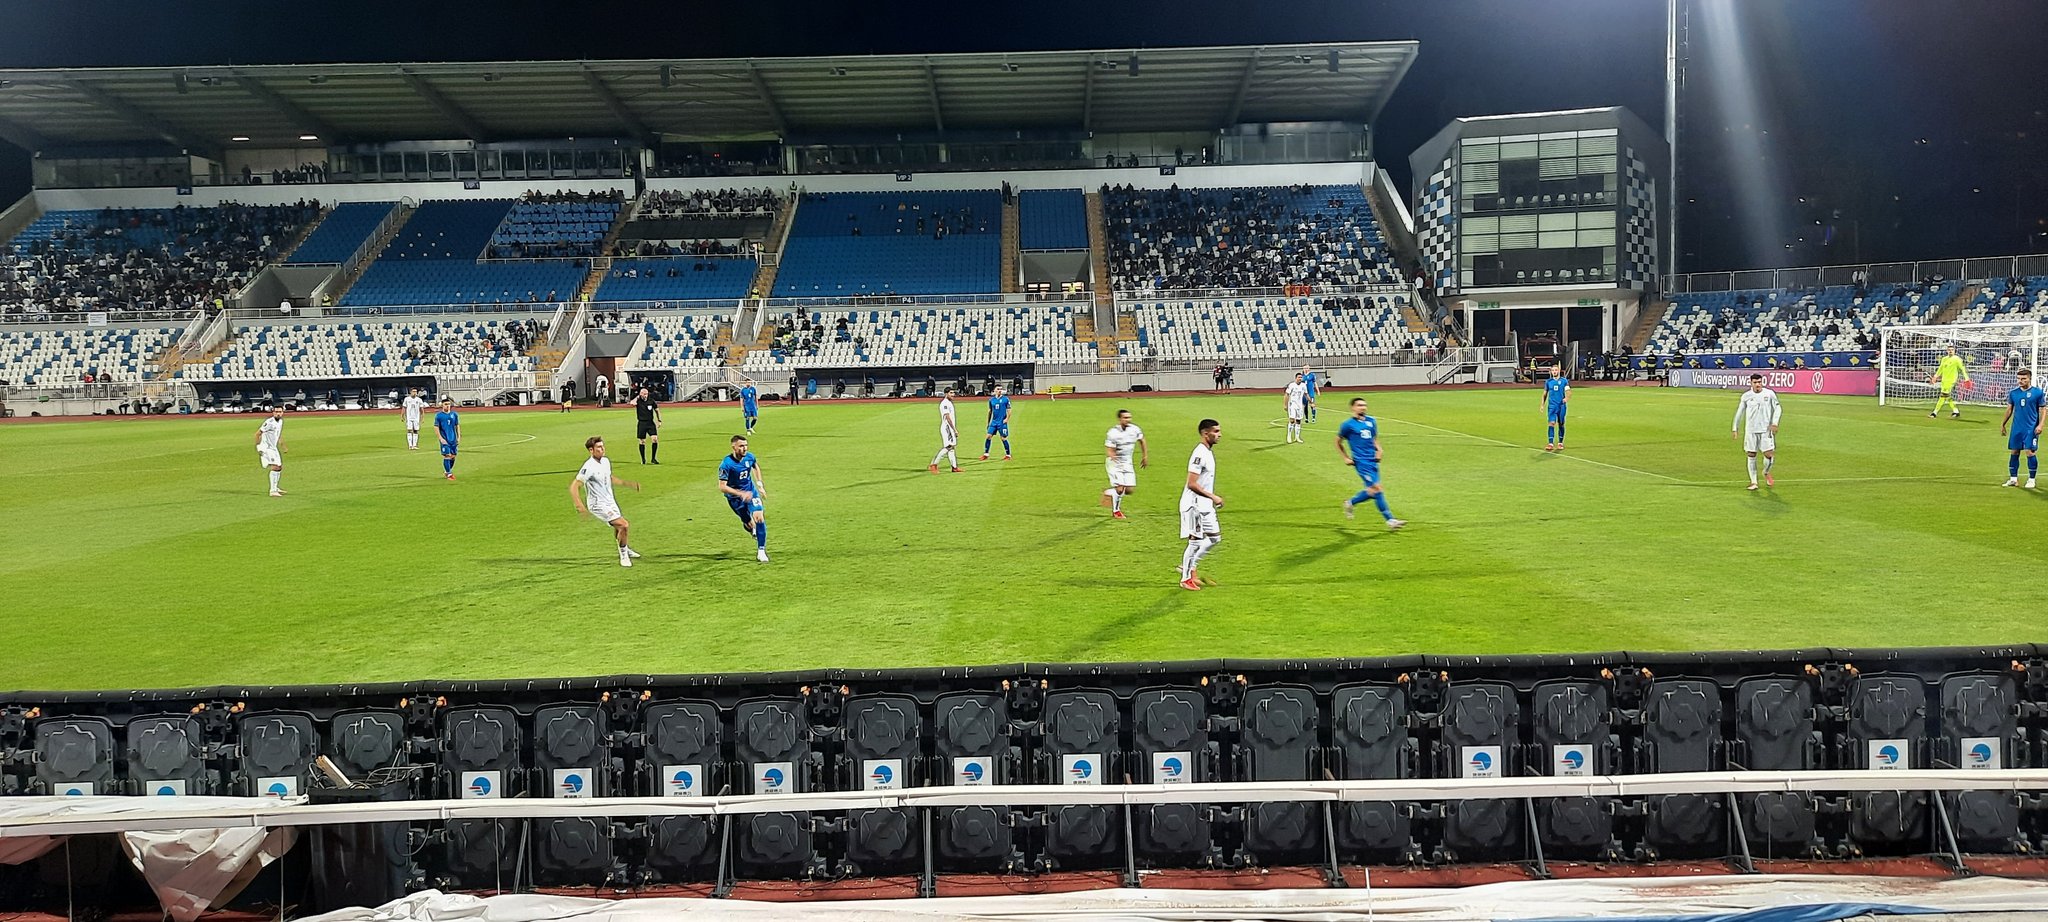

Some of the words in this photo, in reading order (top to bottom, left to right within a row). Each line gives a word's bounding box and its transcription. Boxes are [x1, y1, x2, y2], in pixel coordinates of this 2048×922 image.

[1692, 371, 1737, 389] Volkswagen
[1769, 372, 1795, 387] ZERO
[739, 470, 749, 480] 23
